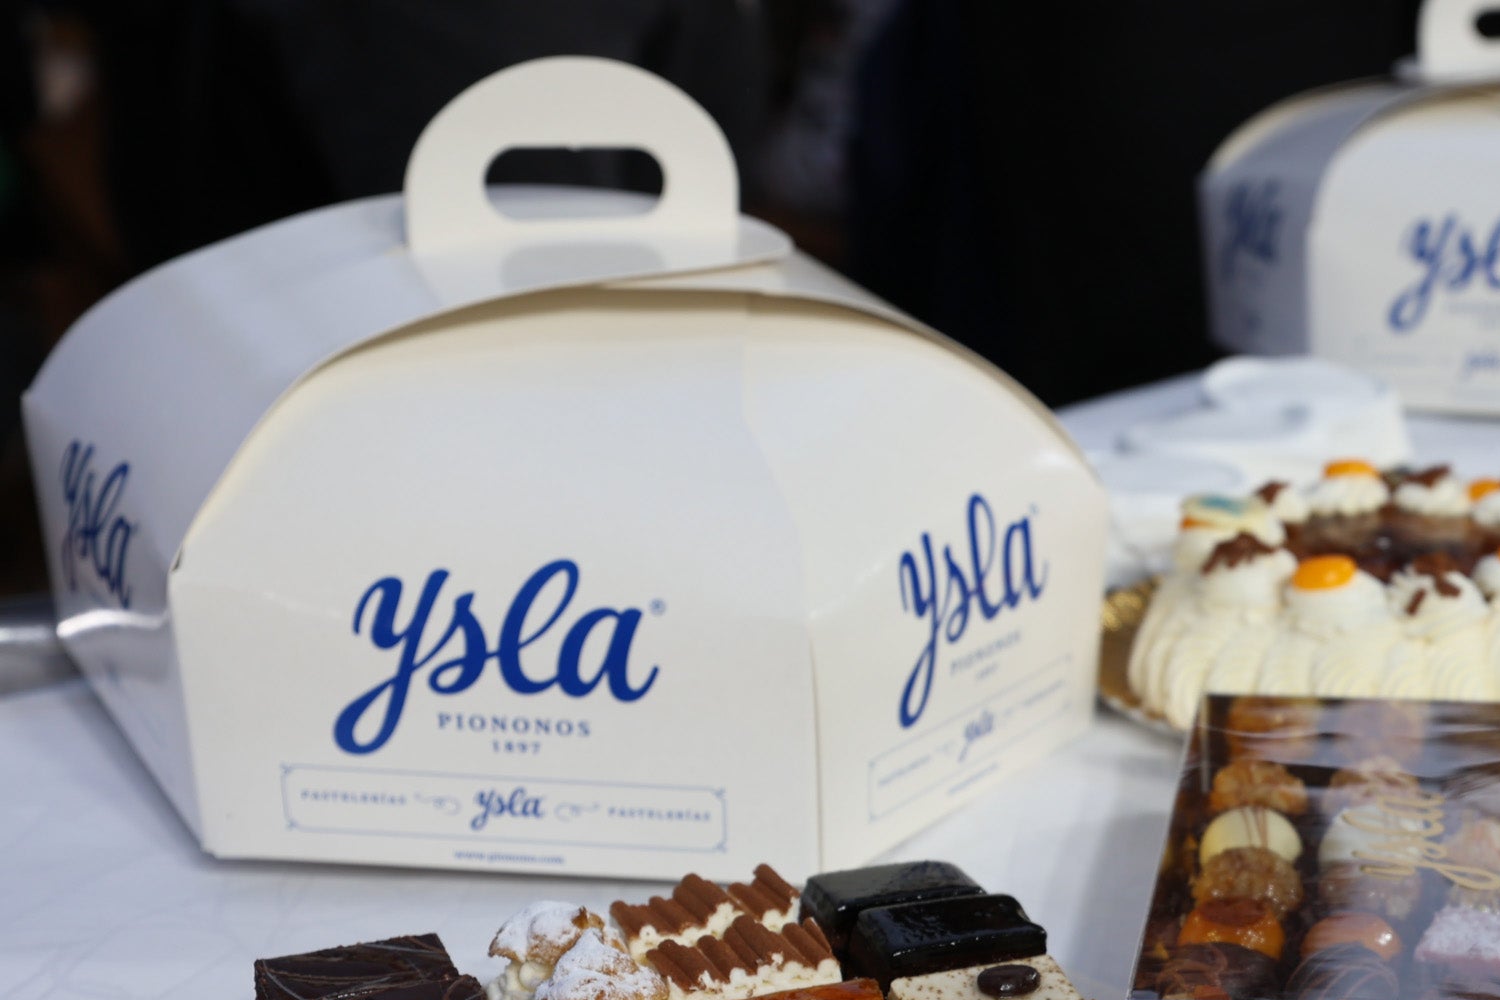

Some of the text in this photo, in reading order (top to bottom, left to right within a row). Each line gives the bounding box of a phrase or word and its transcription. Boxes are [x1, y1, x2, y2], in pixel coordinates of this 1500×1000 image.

[899, 494, 1048, 729] ysla
[333, 558, 660, 755] ysla
[437, 712, 592, 738] PIONONOS
[492, 740, 542, 755] 1897
[470, 786, 545, 831] ysla
